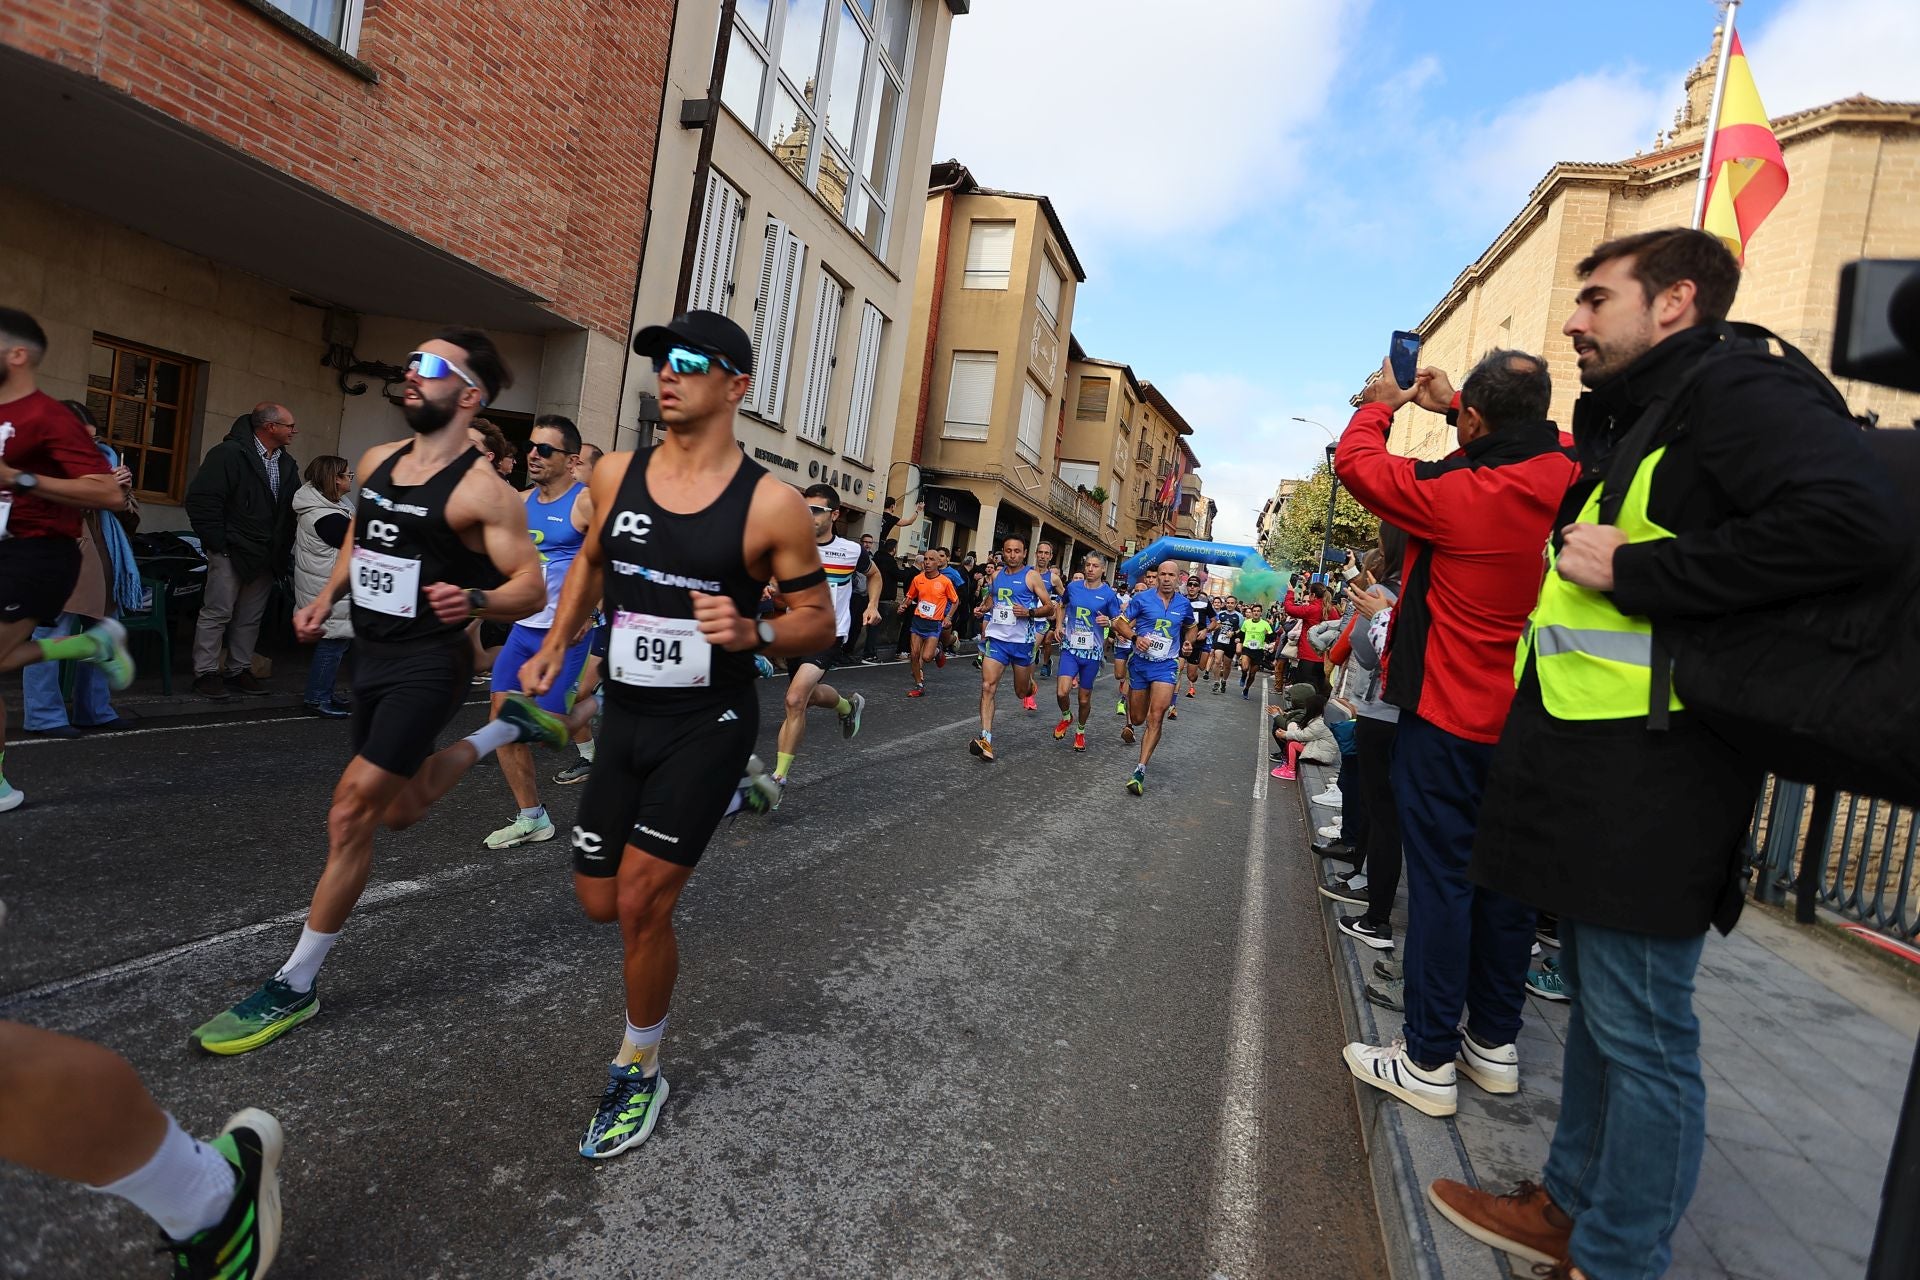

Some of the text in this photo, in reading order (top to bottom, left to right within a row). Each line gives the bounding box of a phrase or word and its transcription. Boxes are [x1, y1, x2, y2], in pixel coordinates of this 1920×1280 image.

[808, 460, 863, 495] OLANO
[938, 495, 957, 513] BBVA
[359, 566, 393, 594] 693
[636, 636, 682, 665] 694
